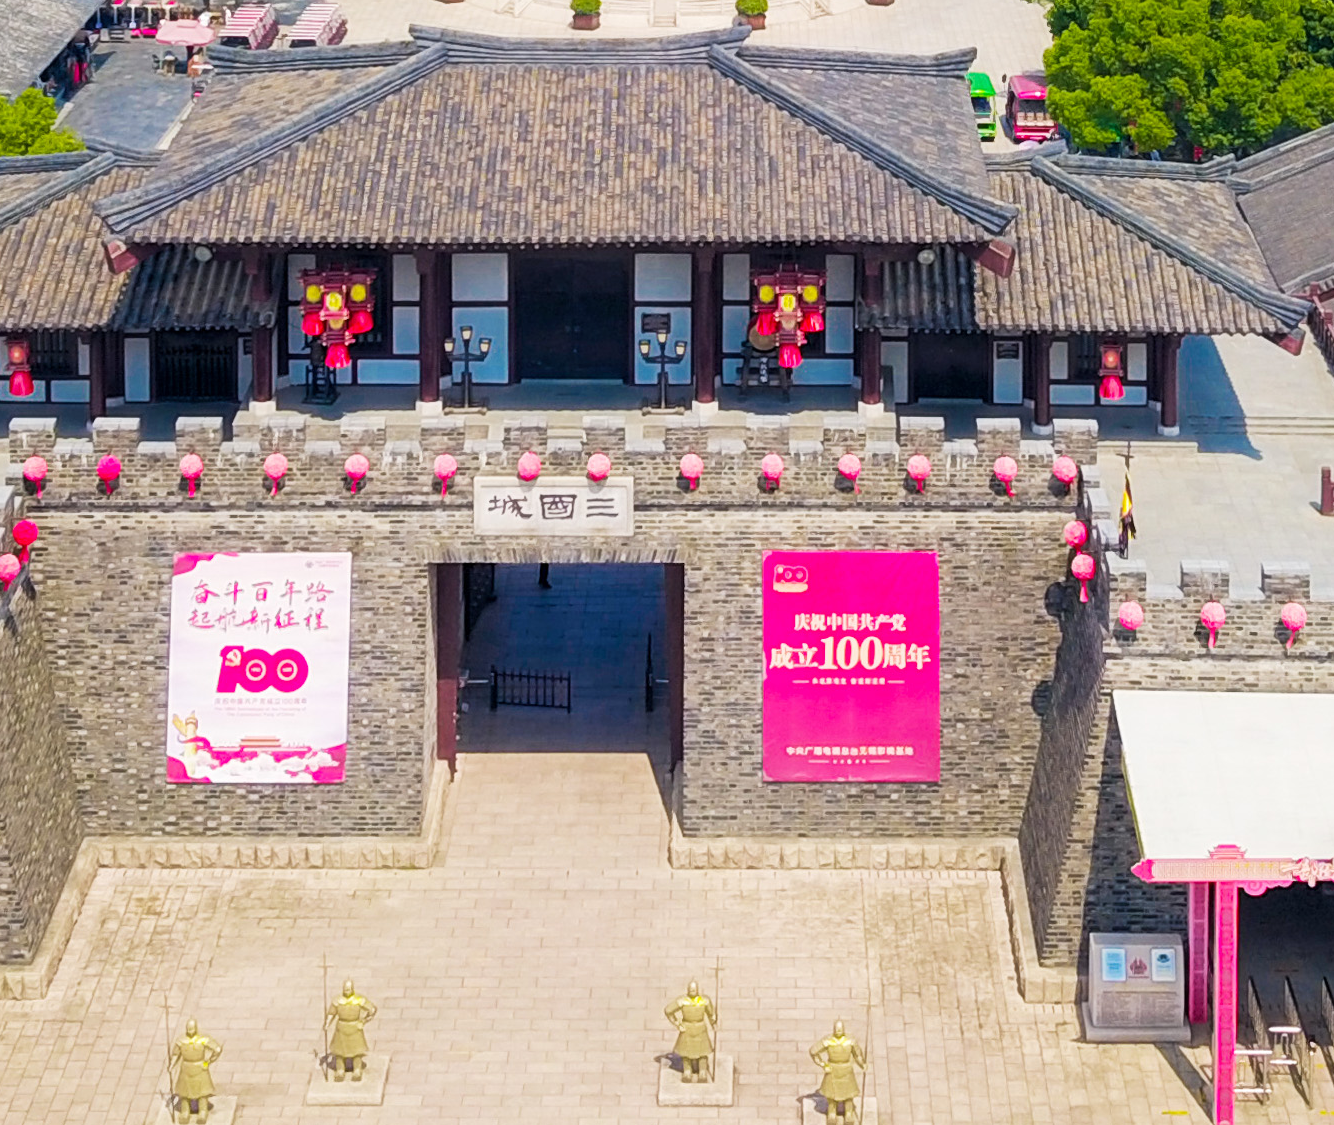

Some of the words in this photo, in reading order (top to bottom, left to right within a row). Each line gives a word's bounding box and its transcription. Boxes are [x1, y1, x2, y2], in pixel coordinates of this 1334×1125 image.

[794, 613, 907, 631] 庆祝中国共产党
[769, 636, 931, 670] 成立100周年
